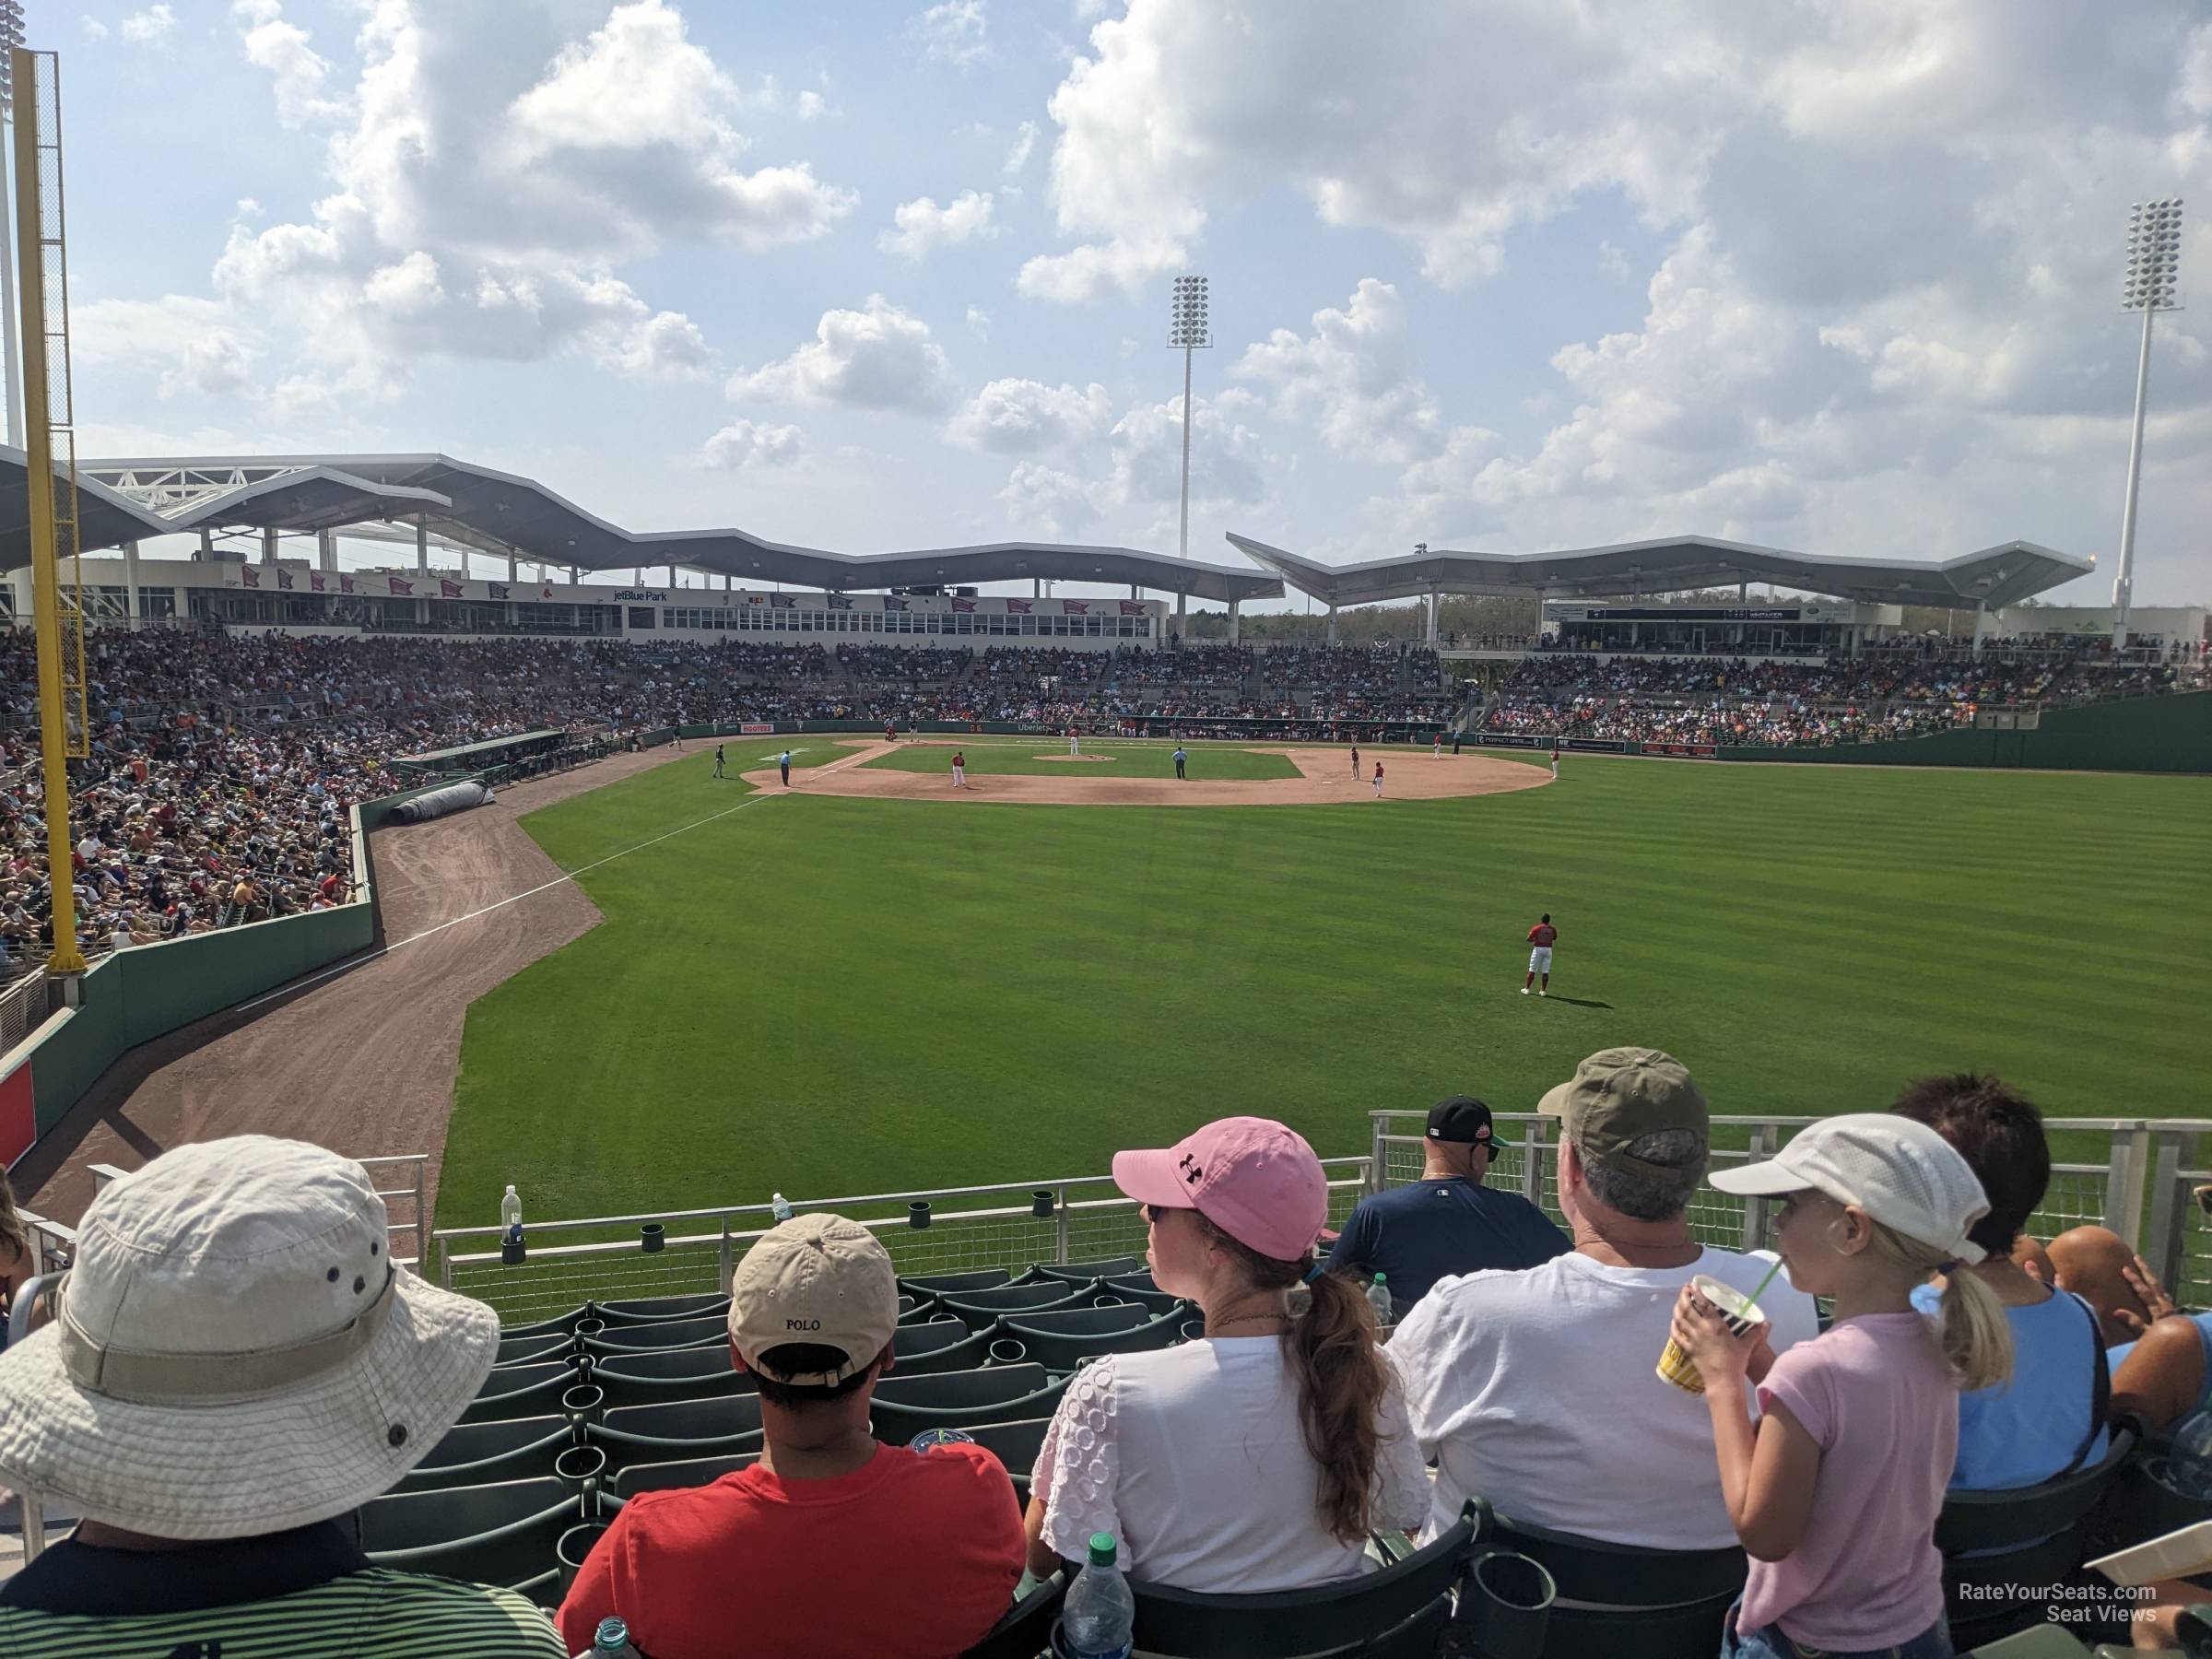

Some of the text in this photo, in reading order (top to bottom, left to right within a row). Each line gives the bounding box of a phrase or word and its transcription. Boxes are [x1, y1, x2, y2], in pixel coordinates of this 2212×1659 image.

[613, 590, 667, 602] jetBlue Park
[785, 1319, 820, 1332] POLO
